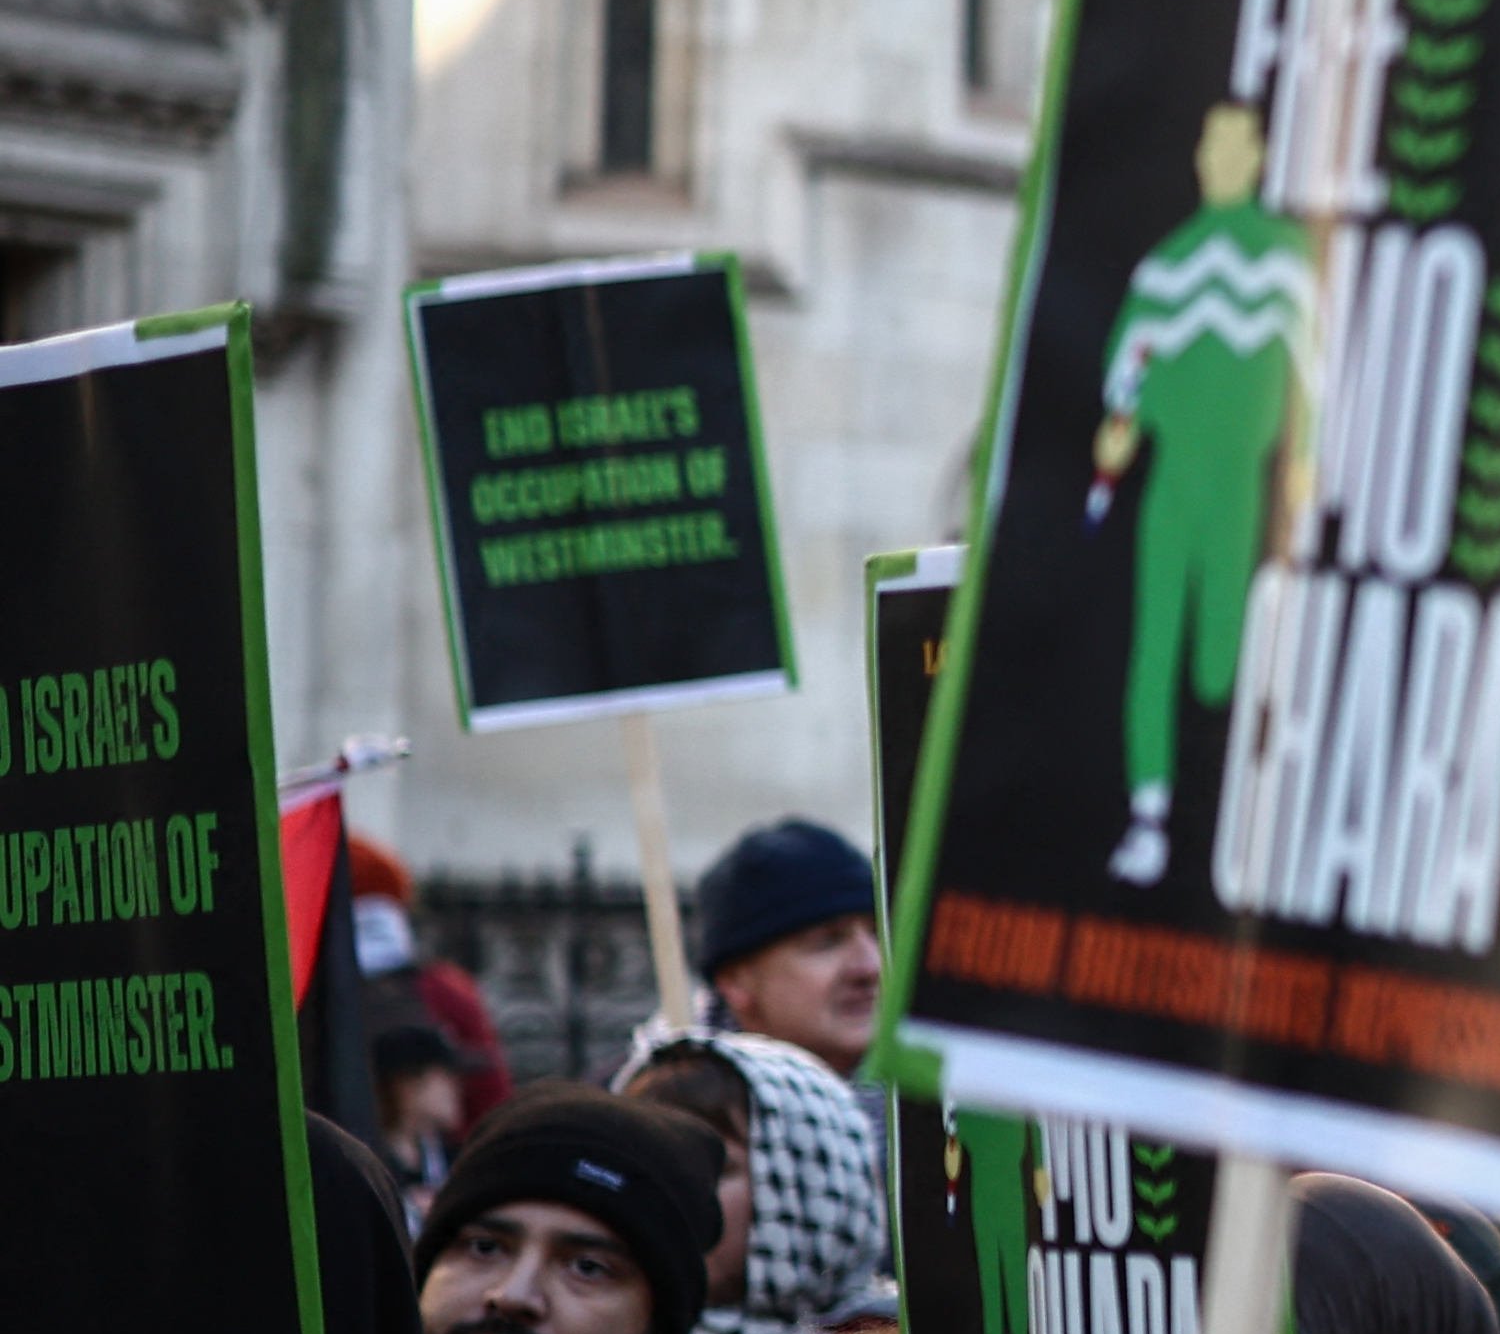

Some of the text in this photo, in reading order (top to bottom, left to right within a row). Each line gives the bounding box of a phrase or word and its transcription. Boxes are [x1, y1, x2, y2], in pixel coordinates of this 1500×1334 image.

[483, 385, 698, 460] END ISRAEL'S
[1288, 221, 1487, 584] MO
[470, 445, 728, 526] OCCUPATION OF
[479, 510, 739, 589] WESTMINSTER.
[20, 657, 182, 775] ISRAEL'S
[166, 811, 220, 916] OF
